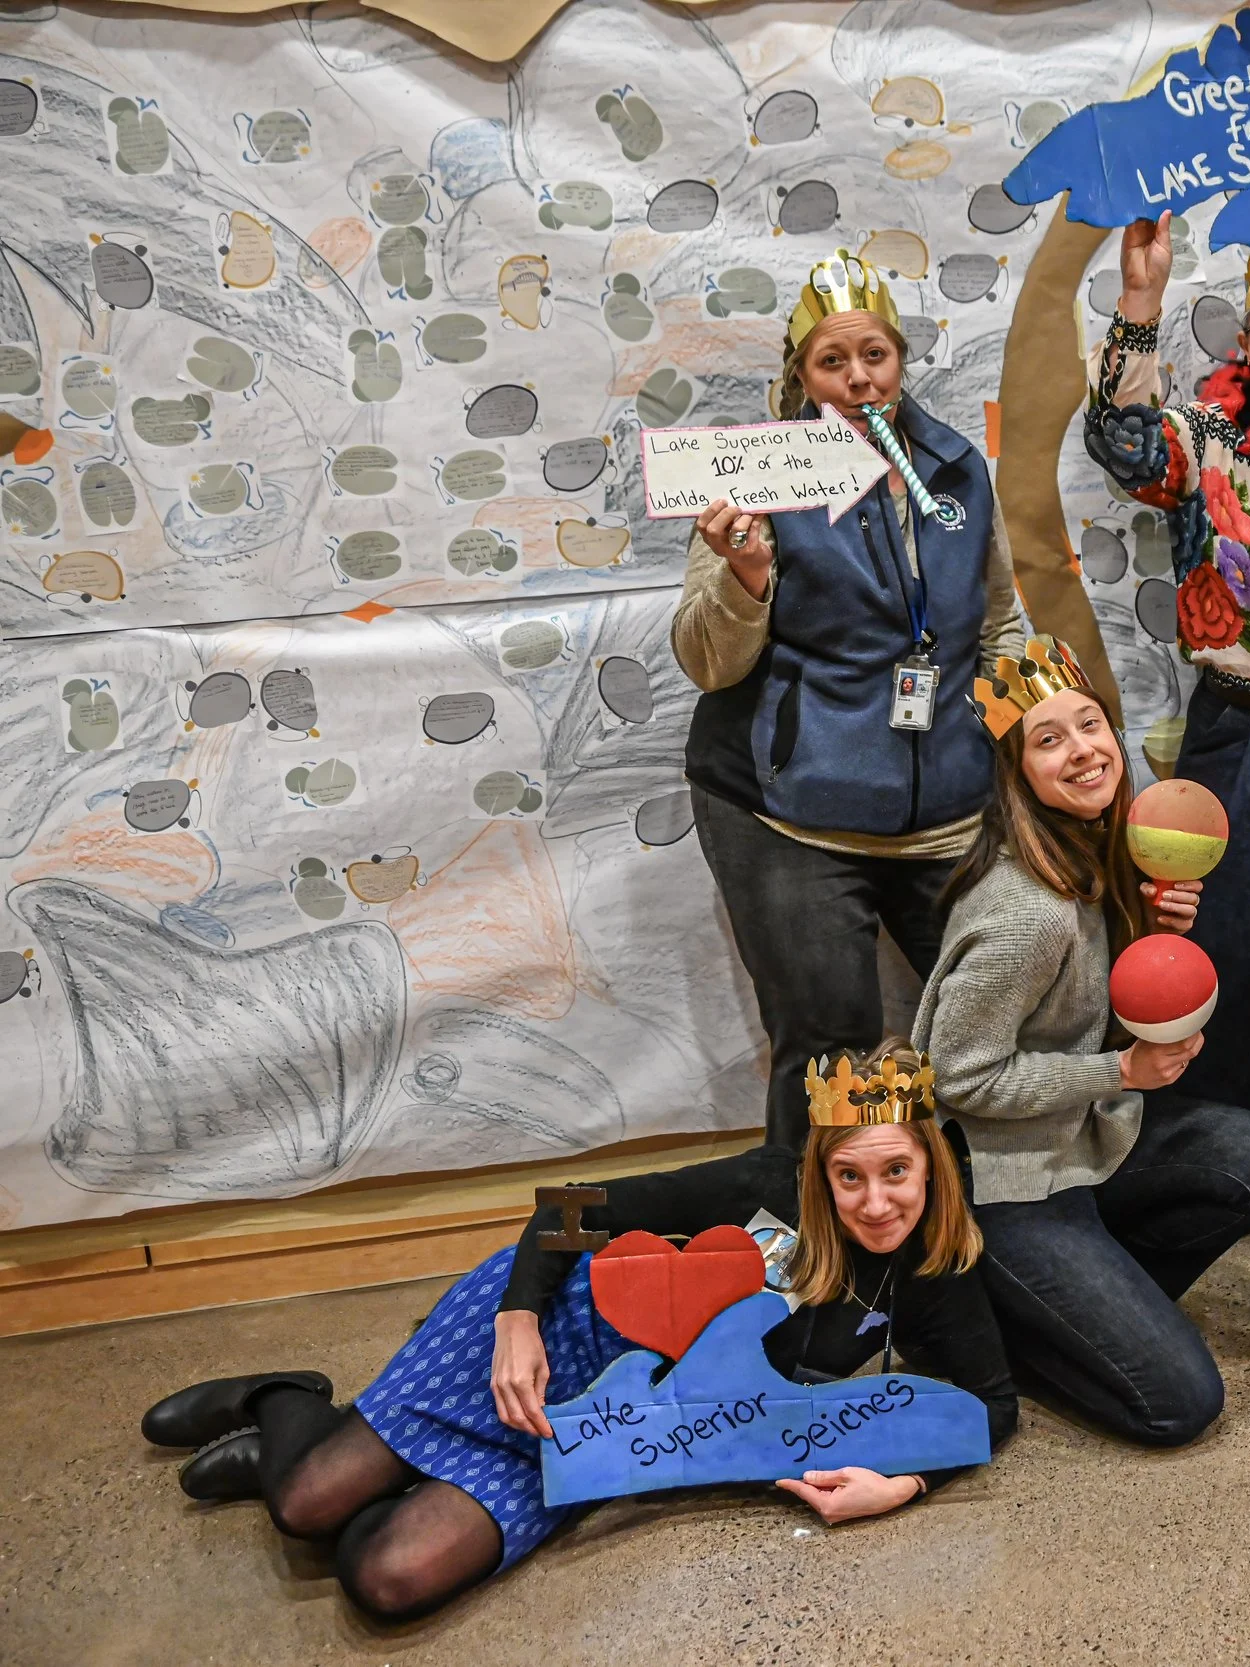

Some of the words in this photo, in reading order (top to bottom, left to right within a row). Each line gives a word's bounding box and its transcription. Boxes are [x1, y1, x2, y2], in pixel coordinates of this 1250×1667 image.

[1136, 156, 1224, 204] LAKE
[651, 436, 700, 454] Lake
[714, 432, 792, 452] Superior
[804, 422, 855, 444] holds
[710, 455, 744, 477] 10%
[757, 454, 771, 470] of
[783, 454, 814, 470] the
[649, 491, 710, 510] Worlds
[730, 484, 779, 507] Fresh
[550, 1395, 647, 1457] Lake
[630, 1390, 768, 1467] Superior
[781, 1377, 916, 1463] Seiches
